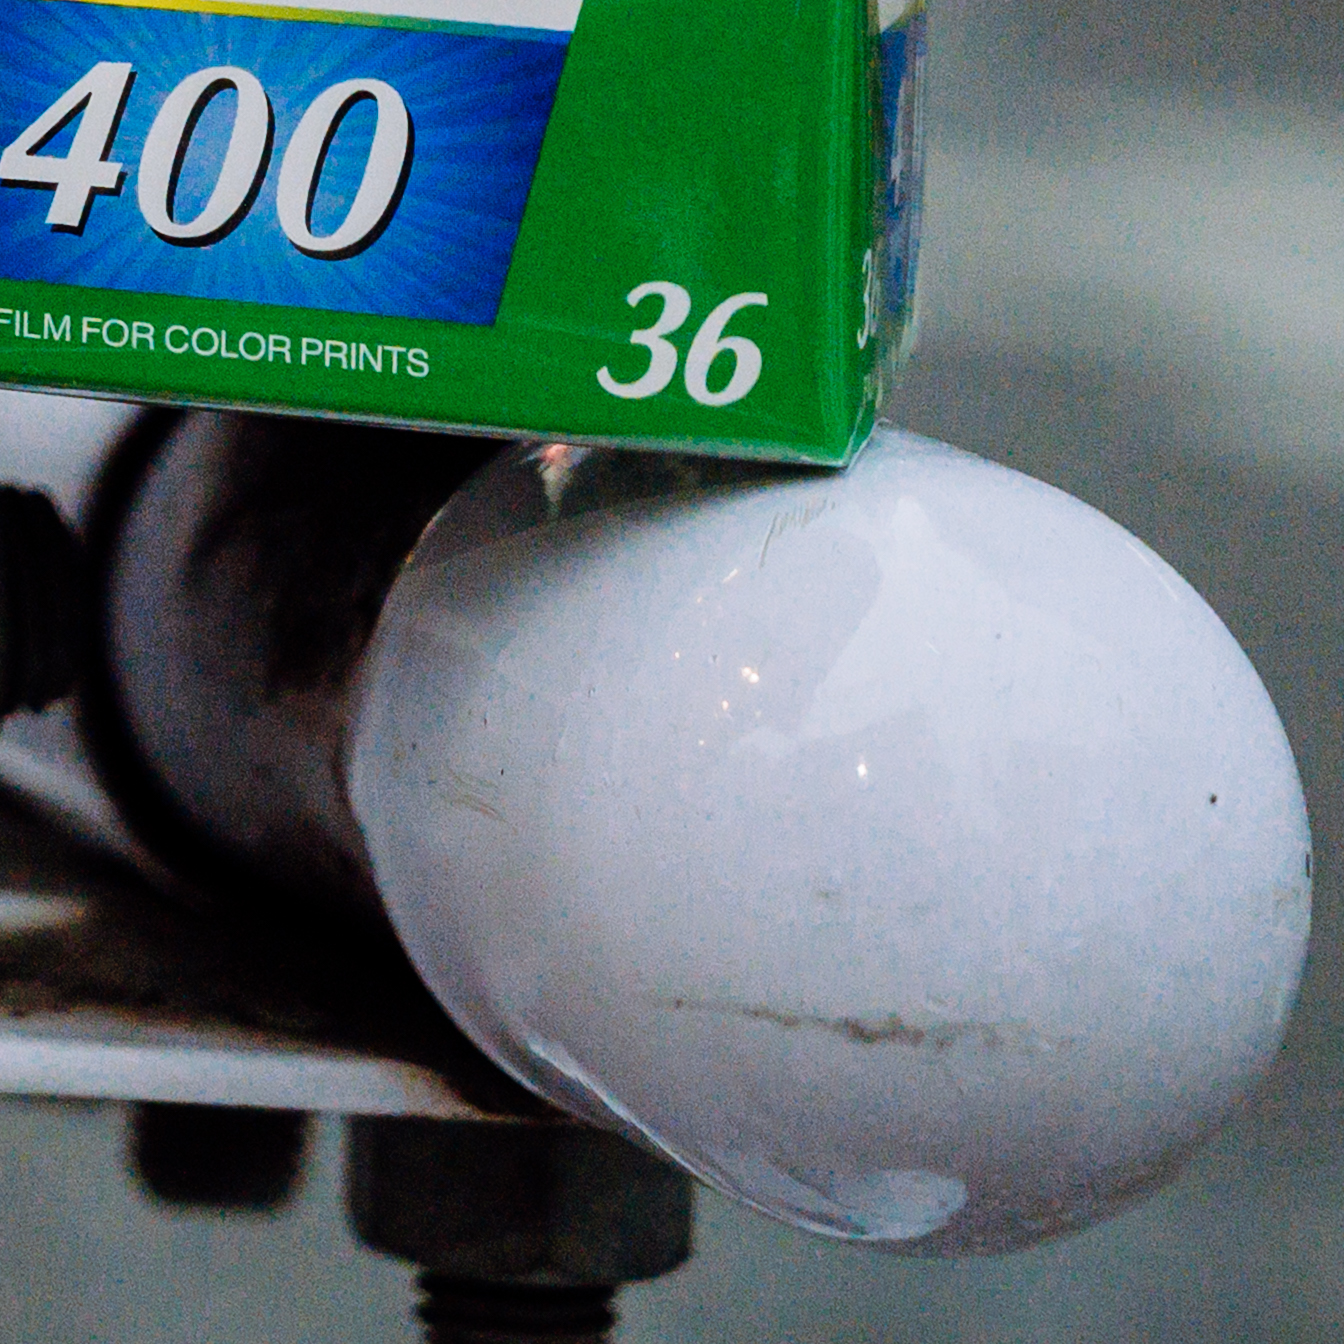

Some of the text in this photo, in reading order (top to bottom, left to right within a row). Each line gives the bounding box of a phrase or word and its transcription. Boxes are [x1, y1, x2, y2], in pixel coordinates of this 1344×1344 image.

[81, 315, 156, 351] FOR
[164, 324, 293, 365] COLOR
[300, 336, 431, 379] PRINTS
[596, 279, 770, 408] 36
